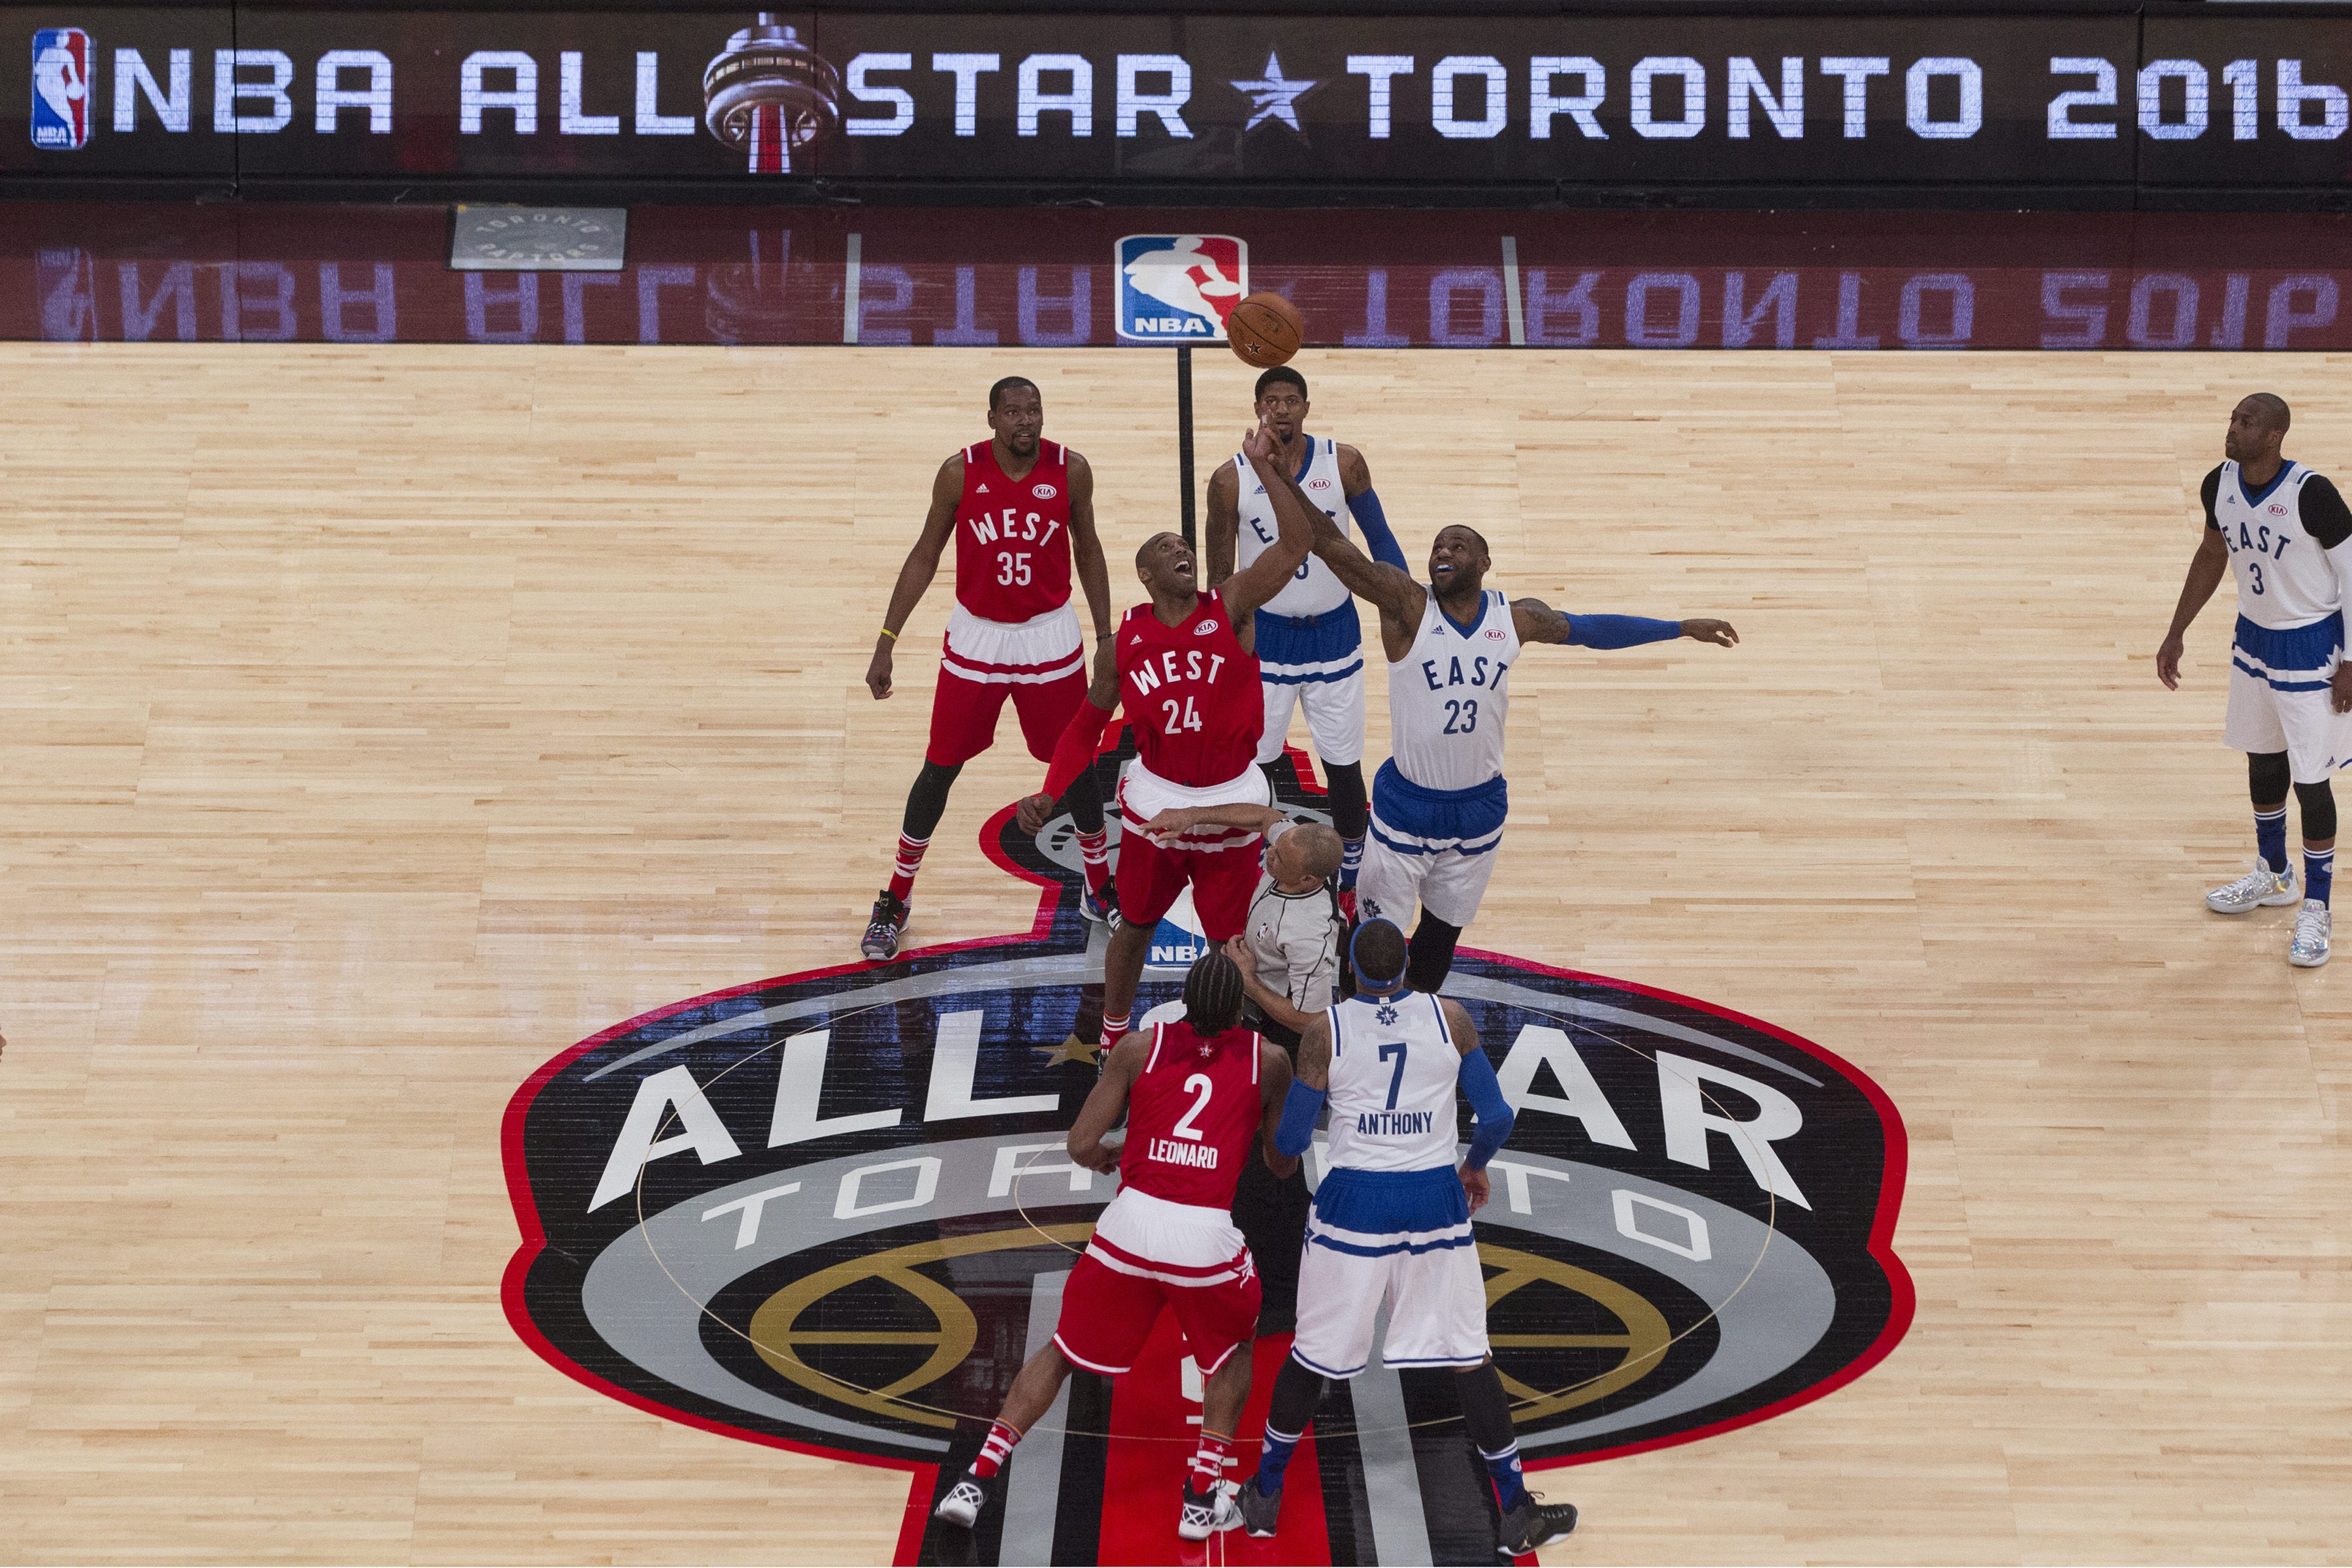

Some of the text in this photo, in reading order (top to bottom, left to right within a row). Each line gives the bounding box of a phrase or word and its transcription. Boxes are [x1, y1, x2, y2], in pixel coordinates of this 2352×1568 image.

[114, 48, 2349, 140] NBA ALL STAR TORONTO 2016
[1135, 318, 1207, 333] NBA
[969, 508, 1060, 546] WEST
[2271, 506, 2284, 515] KIA
[2222, 522, 2291, 561] EAST
[997, 551, 1032, 586] 35
[2249, 563, 2264, 595] 3
[1197, 623, 1213, 632] KIA
[1129, 650, 1225, 696] WEST
[1422, 656, 1508, 691] EAST
[1162, 696, 1203, 734] 24
[1443, 699, 1478, 735] 23
[1379, 1042, 1407, 1111] 7
[587, 1009, 1060, 1214] ALL
[1172, 1073, 1213, 1141] 2
[1358, 1111, 1433, 1135] ANTHONY
[1148, 1137, 1218, 1170] LEONARD
[701, 1141, 1712, 1262] TORTO
